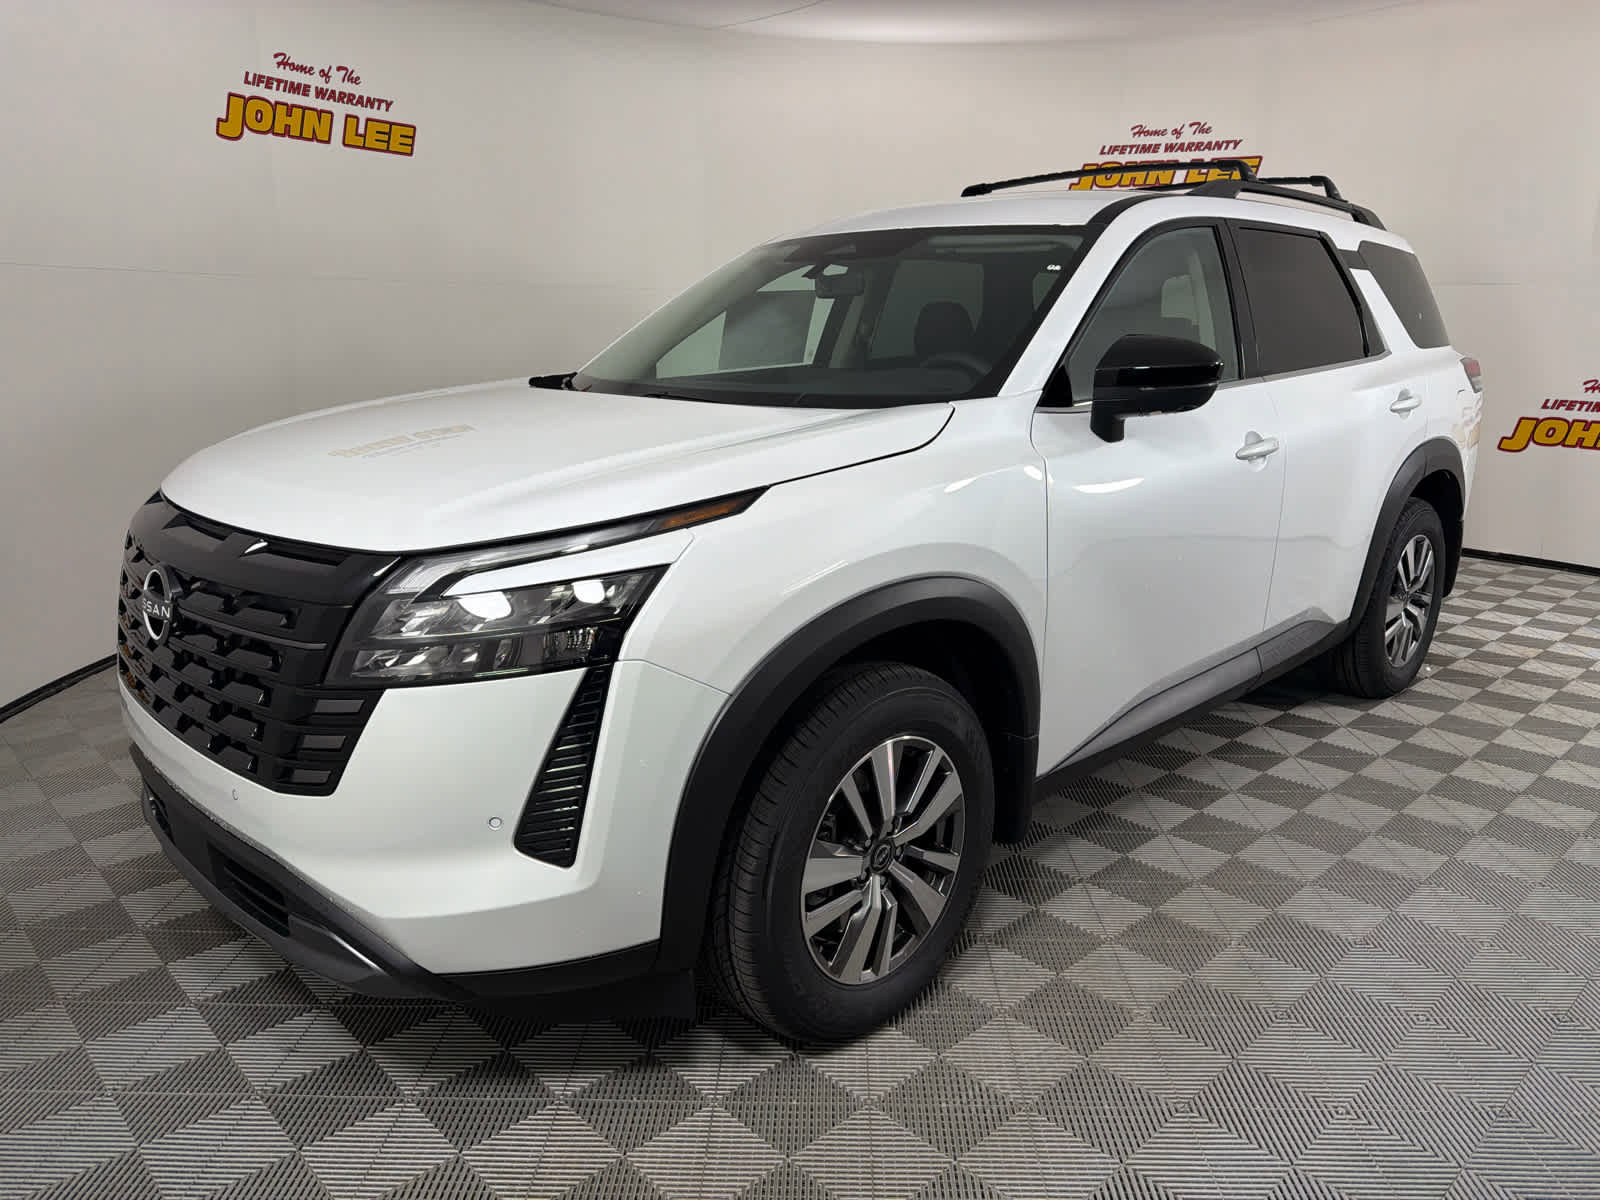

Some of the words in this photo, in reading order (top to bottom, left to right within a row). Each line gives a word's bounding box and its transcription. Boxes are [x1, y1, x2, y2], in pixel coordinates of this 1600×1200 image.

[273, 52, 316, 76] Home
[319, 65, 332, 84] of
[336, 66, 362, 85] The
[244, 71, 312, 97] LIFETIME
[314, 86, 394, 112] WARRANTY
[216, 92, 334, 144] JOHN
[343, 114, 417, 157] LEE
[1130, 124, 1168, 138] Home
[1171, 124, 1185, 140] of
[1189, 121, 1213, 136] The
[1099, 143, 1161, 156] LIFETIME
[1163, 139, 1243, 153] WARRANTY
[1069, 159, 1179, 191] JOHN
[1497, 416, 1600, 452] JOH
